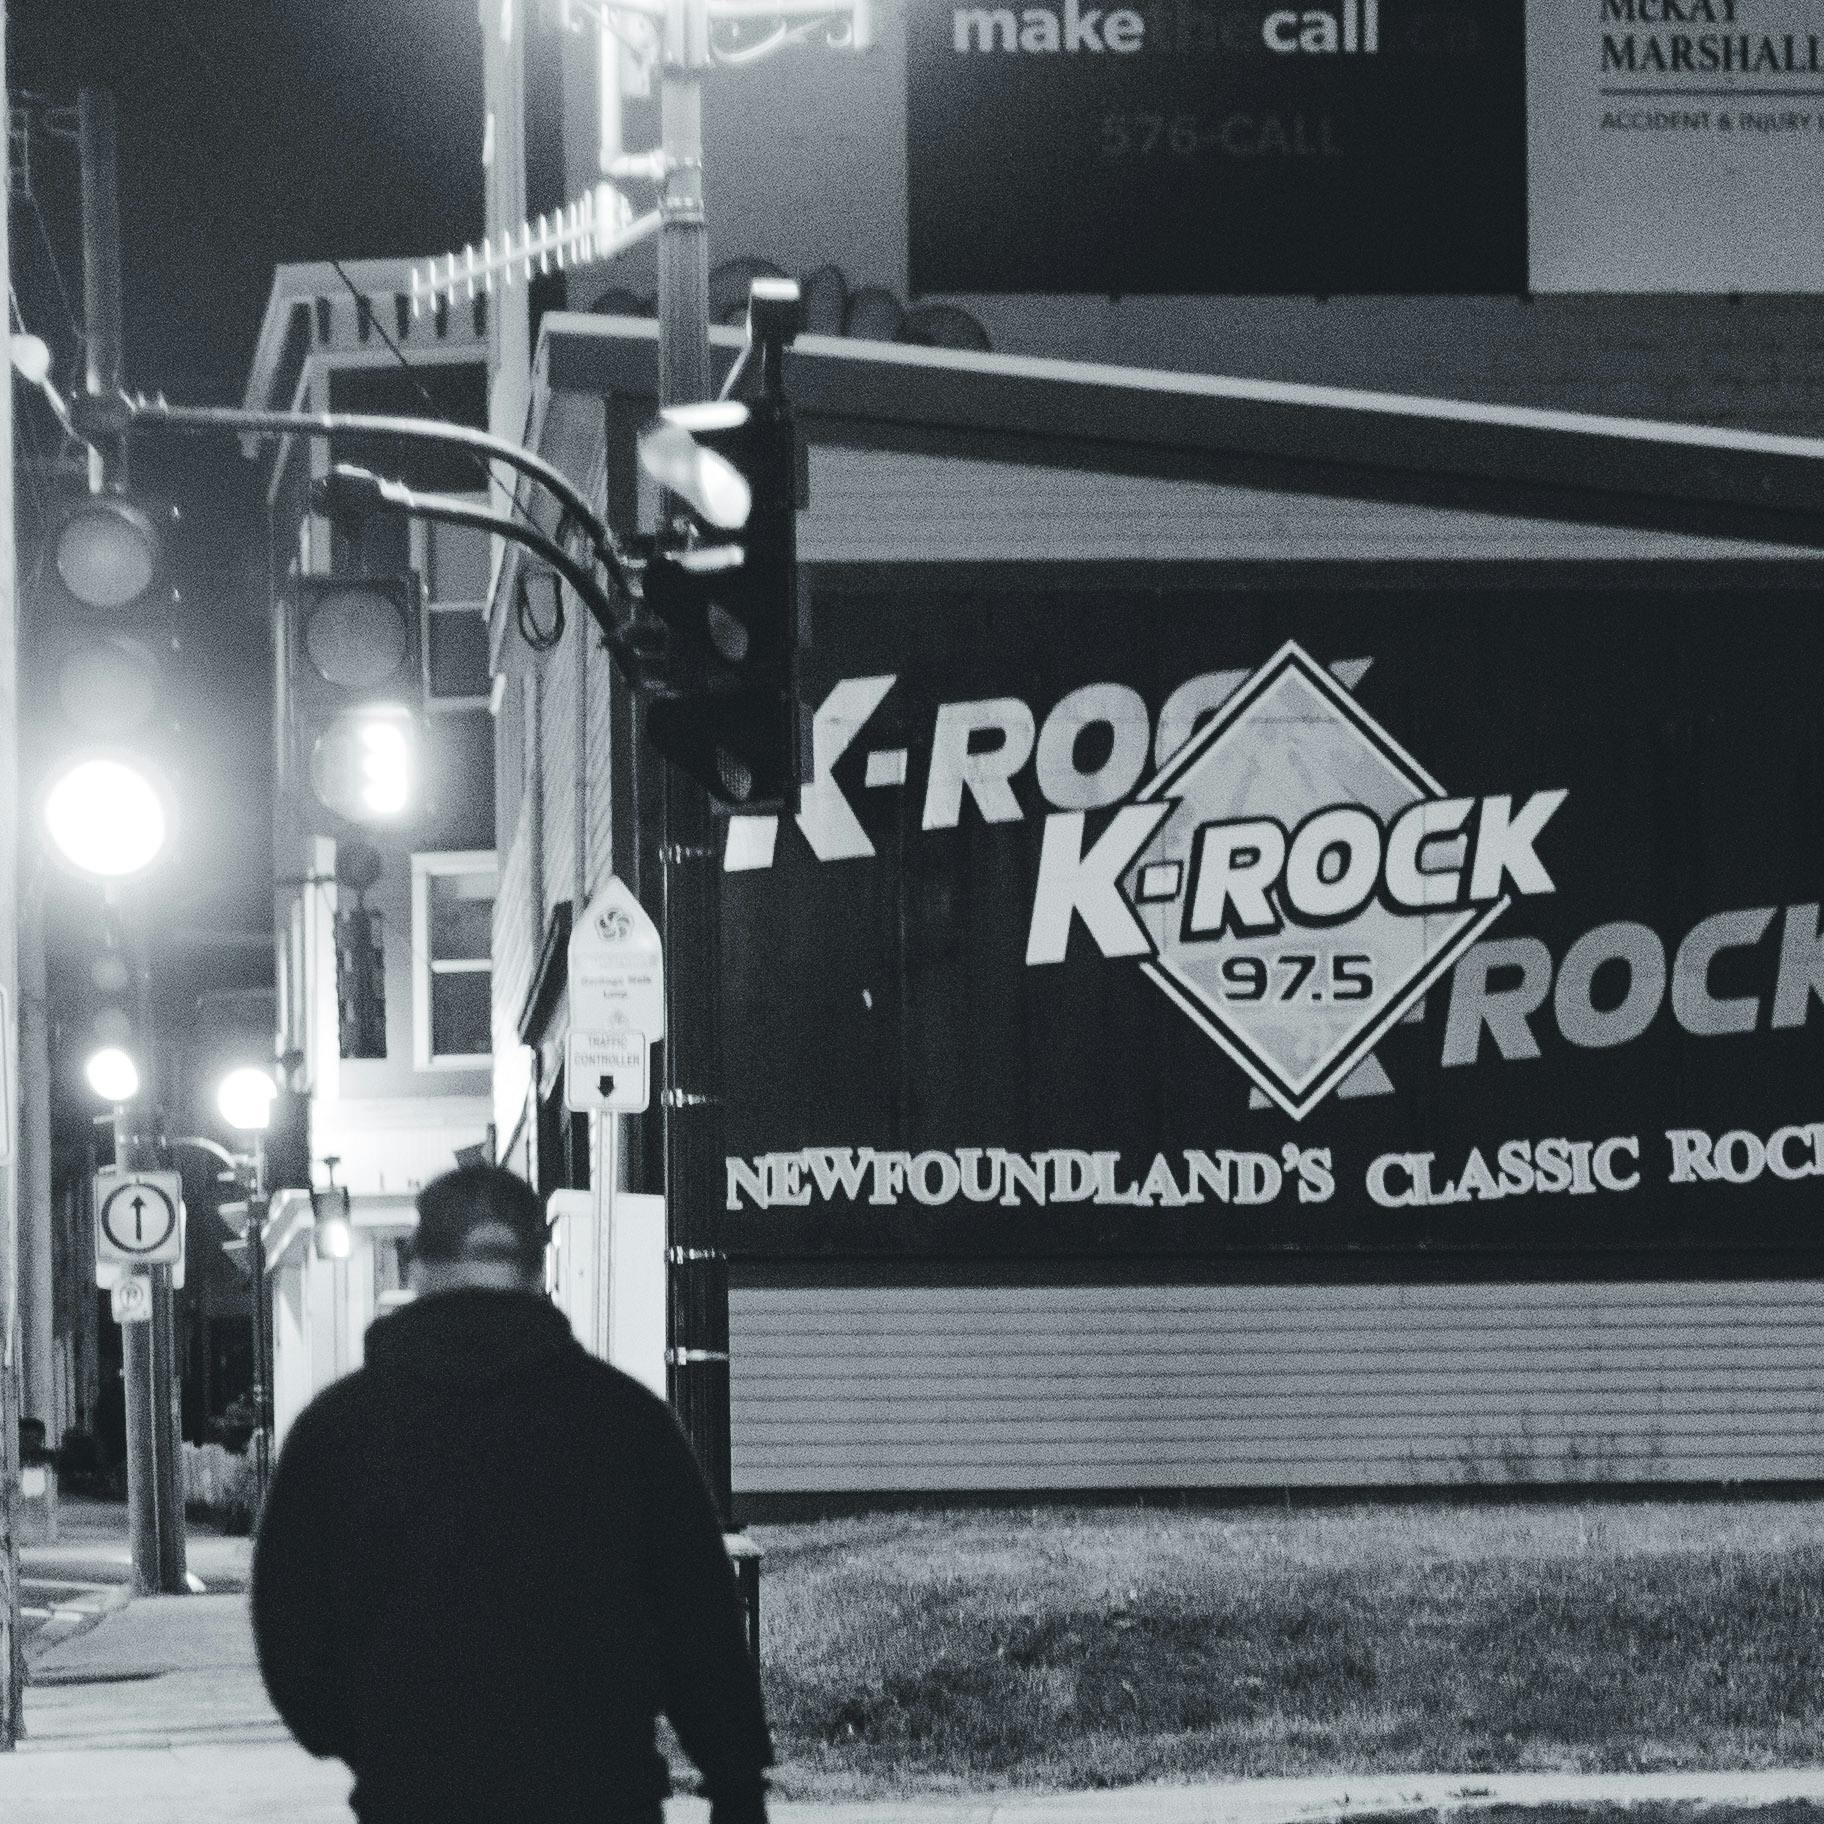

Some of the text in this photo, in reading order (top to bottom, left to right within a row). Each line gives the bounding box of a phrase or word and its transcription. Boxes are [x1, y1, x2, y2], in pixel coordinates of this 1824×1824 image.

[1600, 111, 1709, 131] ACCIDENT
[1739, 112, 1812, 133] INJURY
[1026, 788, 1569, 967] K-ROCK
[1221, 954, 1374, 1001] 97.5
[588, 1036, 628, 1049] TRAFFIC
[574, 1053, 641, 1067] CONTROLLER
[725, 1142, 1336, 1210] NEWFOUNDLAND'S
[1365, 1136, 1642, 1208] CLASSIC
